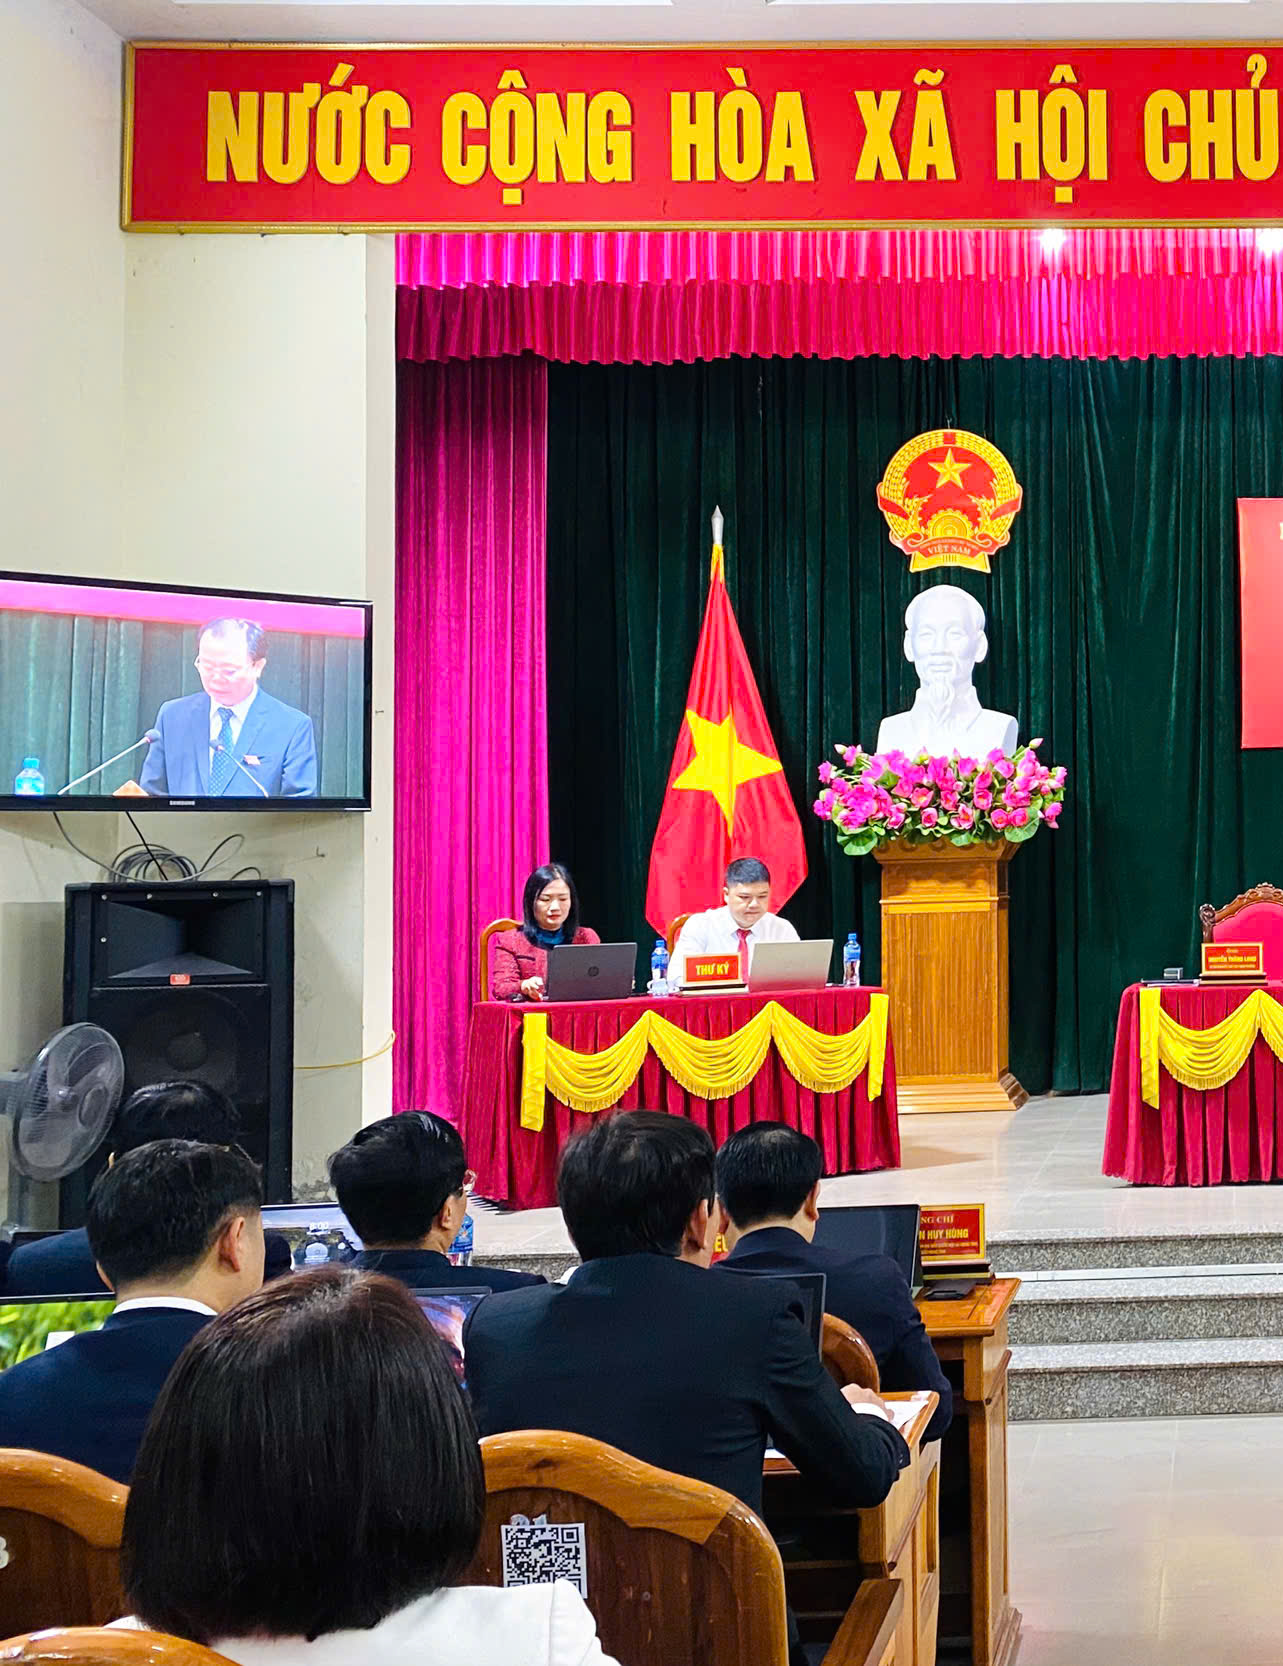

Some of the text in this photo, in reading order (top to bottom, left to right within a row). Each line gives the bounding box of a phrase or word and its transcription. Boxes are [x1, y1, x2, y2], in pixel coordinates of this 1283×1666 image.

[206, 62, 411, 185] NƯỚC
[441, 69, 633, 205] CỘNG
[670, 67, 815, 183] HÒA
[854, 68, 957, 181] XÃ
[995, 64, 1108, 203] HỘI
[1143, 53, 1279, 183] CHỦ
[696, 961, 729, 976] THƯ KÝ
[936, 1214, 954, 1224] CHÍ
[927, 1229, 943, 1240] HUY
